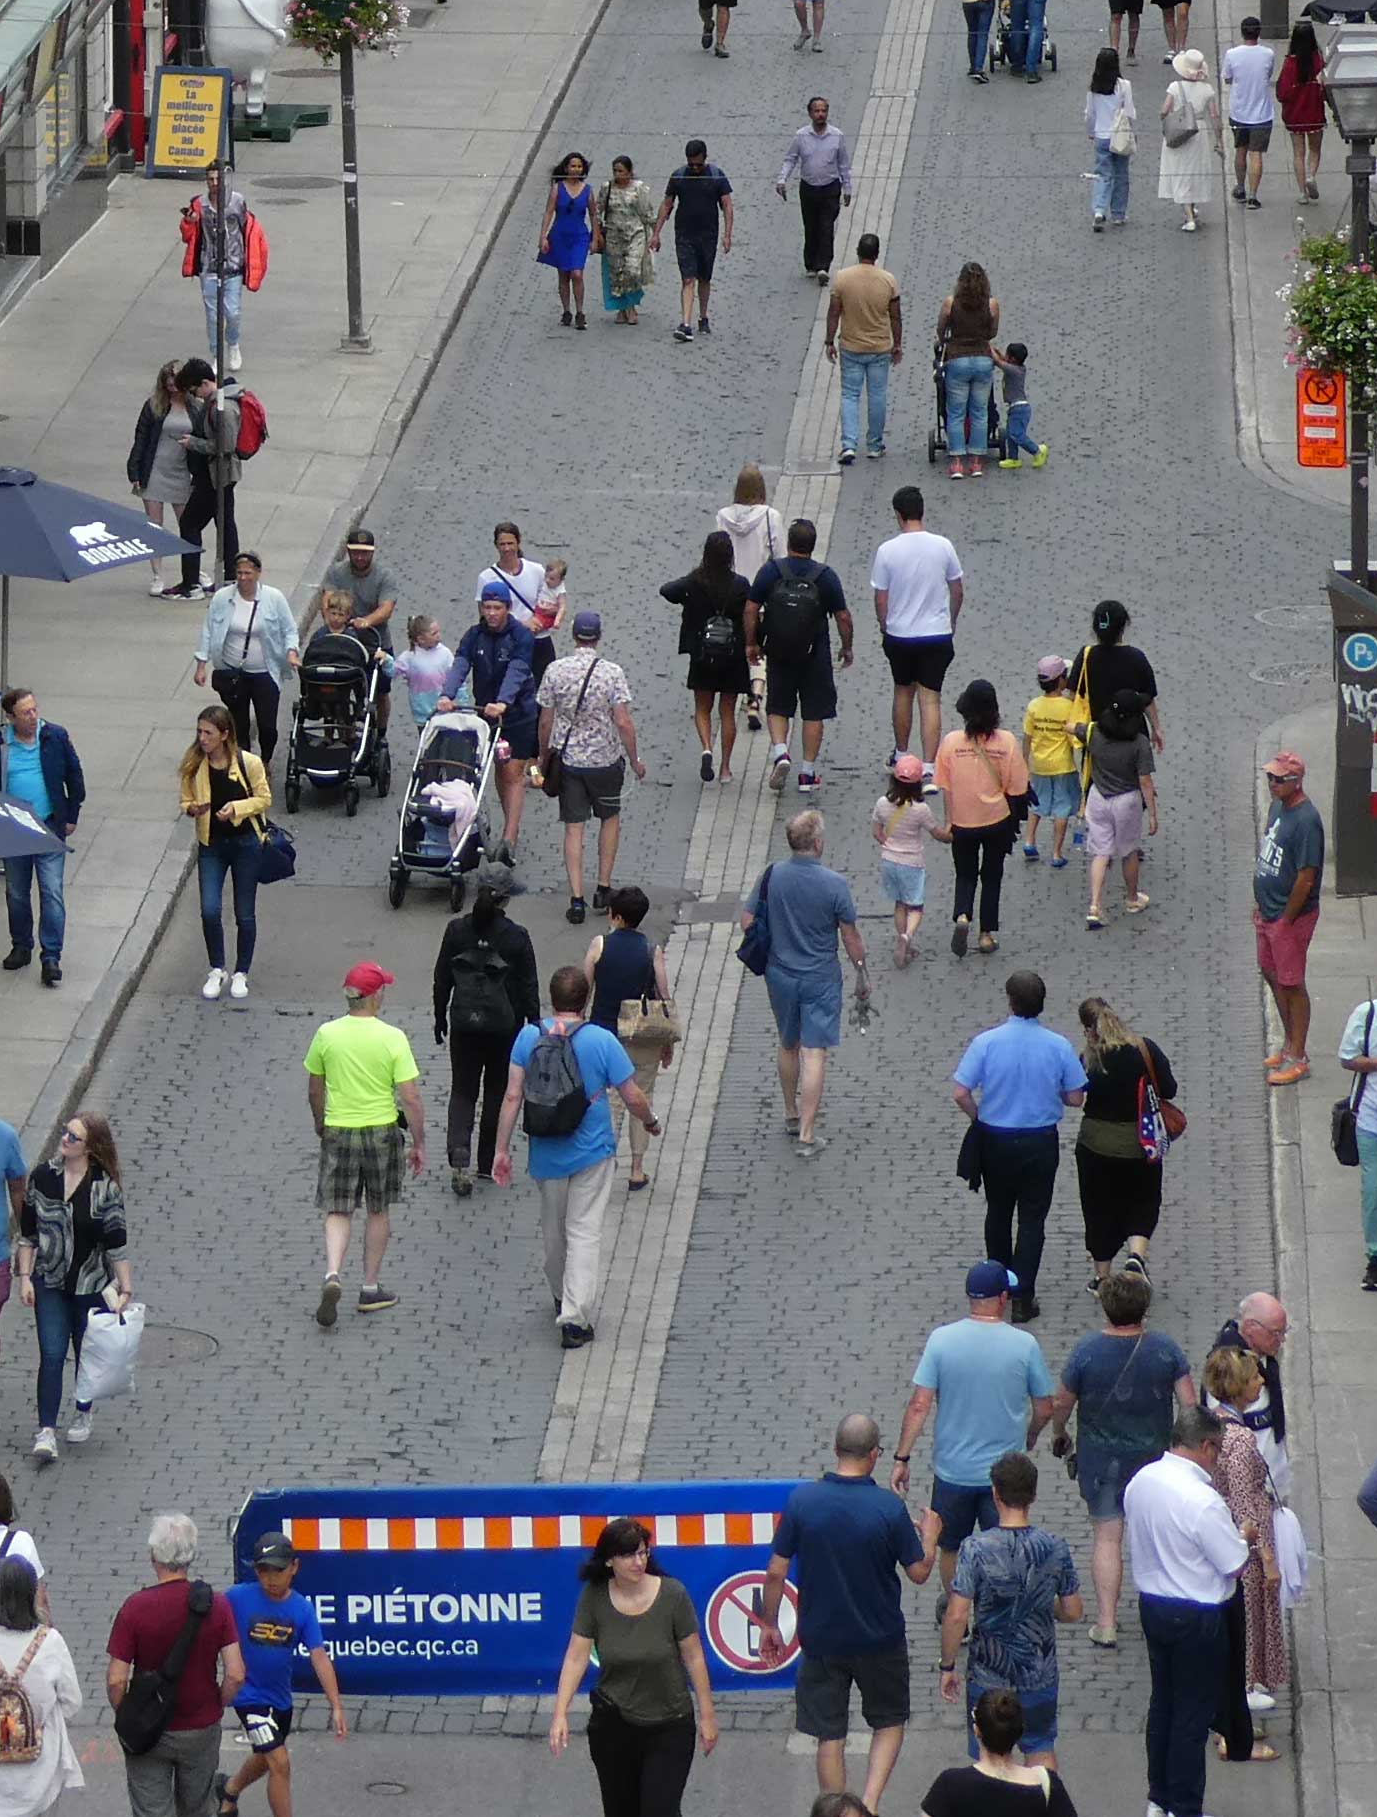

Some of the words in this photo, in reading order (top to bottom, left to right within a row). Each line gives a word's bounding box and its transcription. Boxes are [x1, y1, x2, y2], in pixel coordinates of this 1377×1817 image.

[186, 89, 197, 99] La
[168, 146, 205, 156] Canada
[347, 1587, 542, 1624] PIÉTONNE
